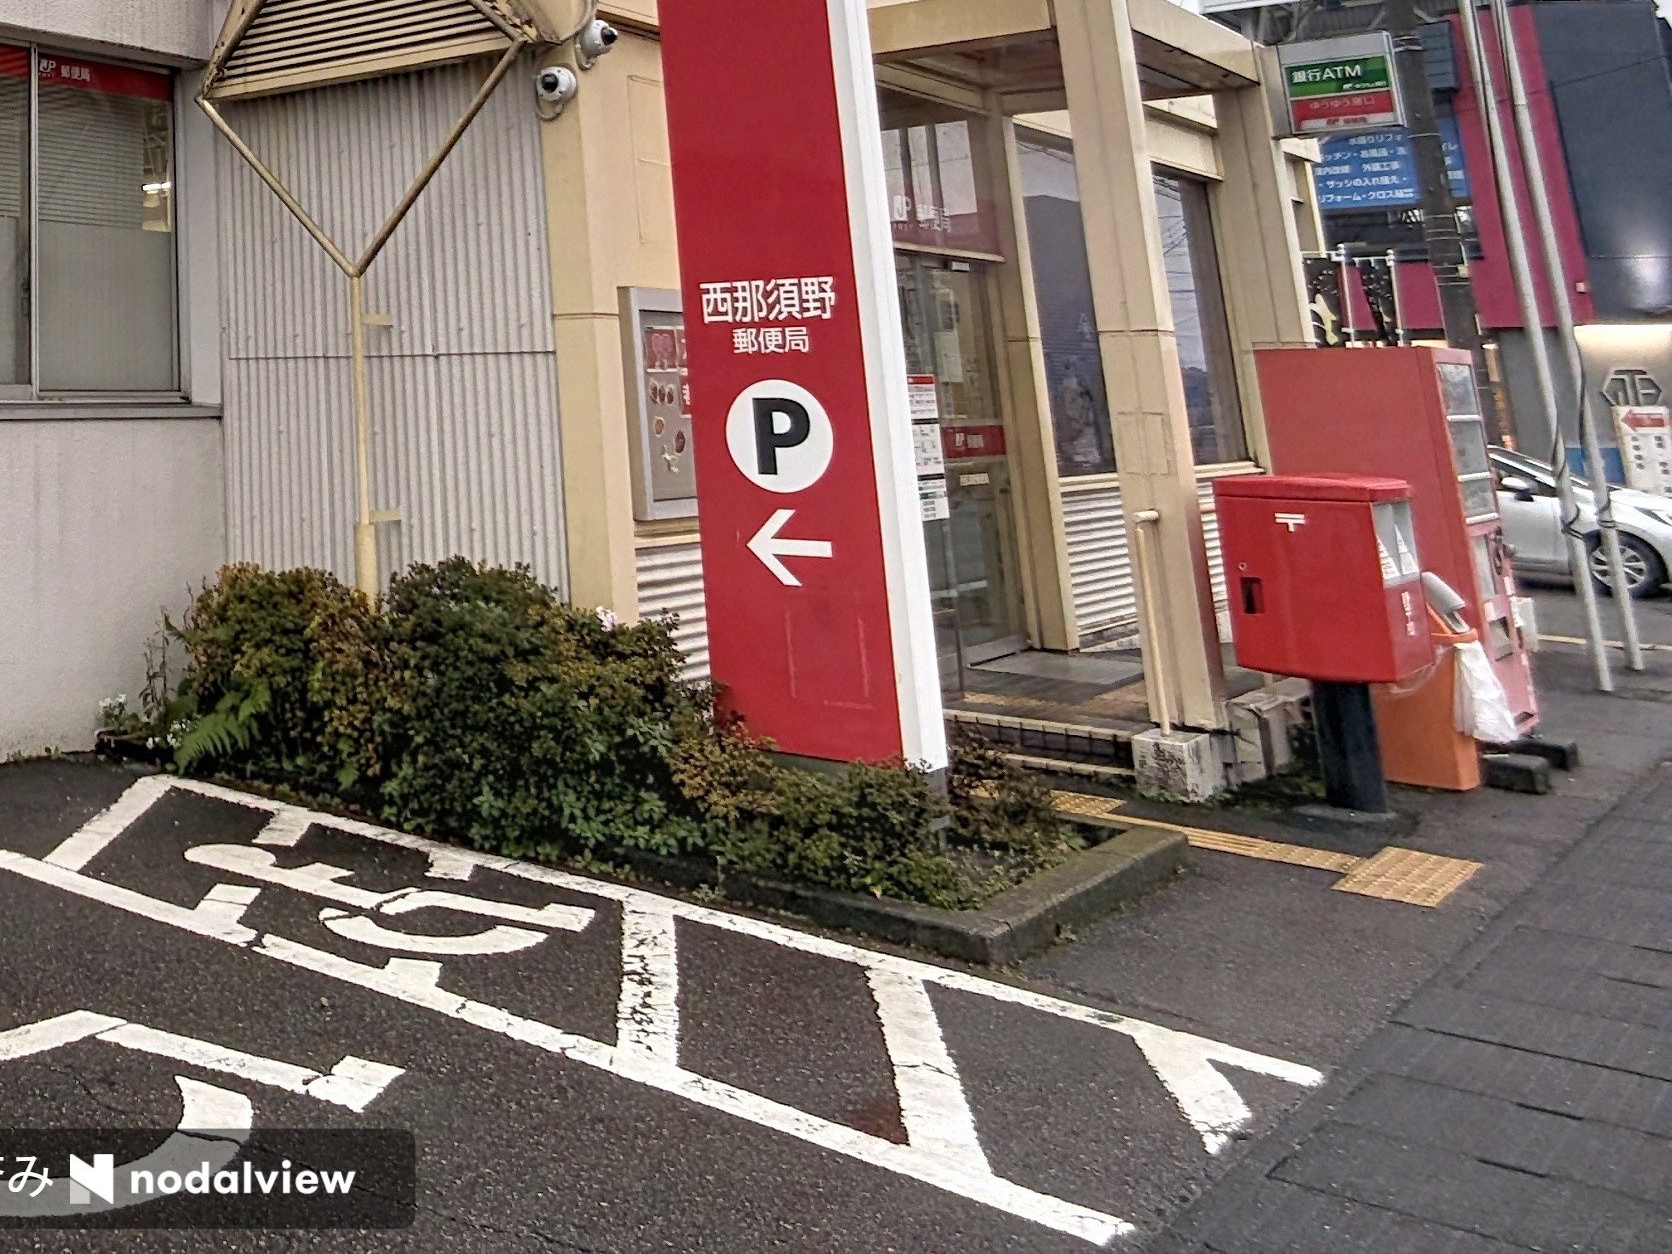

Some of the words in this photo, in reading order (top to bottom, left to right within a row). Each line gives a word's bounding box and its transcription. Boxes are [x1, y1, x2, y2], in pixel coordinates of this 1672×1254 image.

[1291, 64, 1362, 83] 銀行ATM
[699, 276, 836, 324] 西那須野
[732, 326, 810, 354] 郵便局
[752, 397, 810, 475] P
